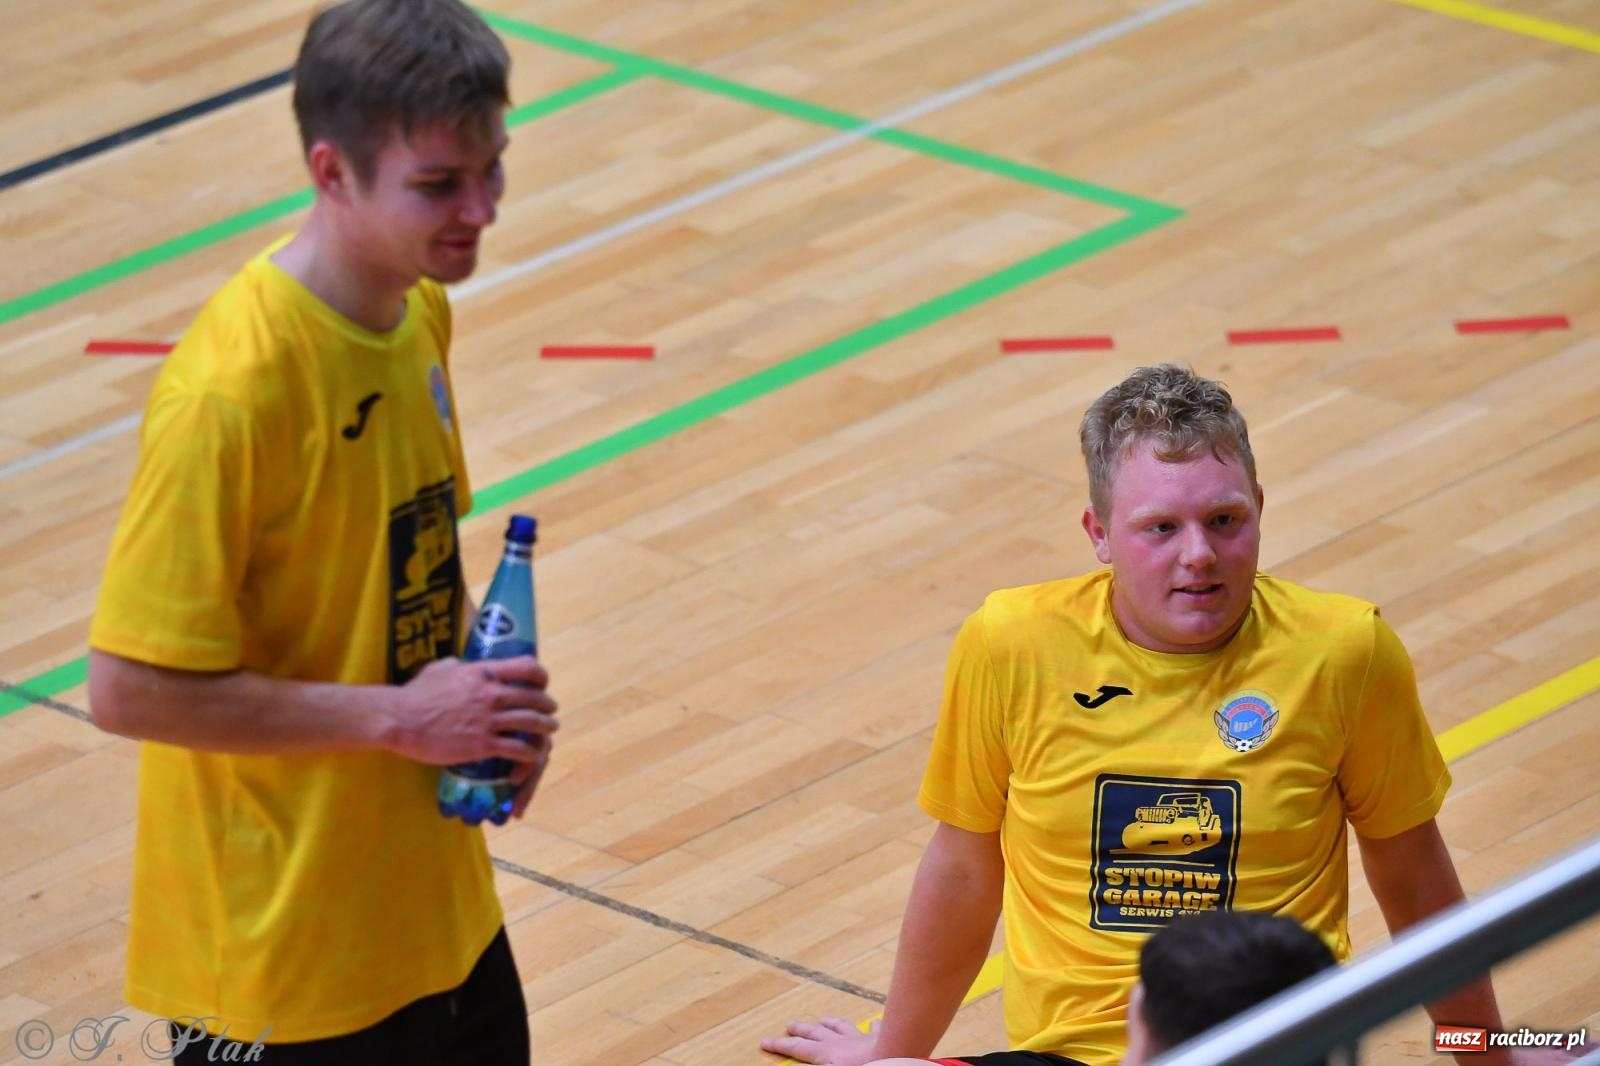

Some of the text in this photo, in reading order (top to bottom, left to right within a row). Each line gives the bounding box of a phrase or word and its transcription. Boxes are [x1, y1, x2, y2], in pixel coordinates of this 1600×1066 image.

[1104, 867, 1221, 890] STOPIW
[1102, 888, 1221, 912] GARAGE
[1119, 906, 1174, 918] SERWIS
